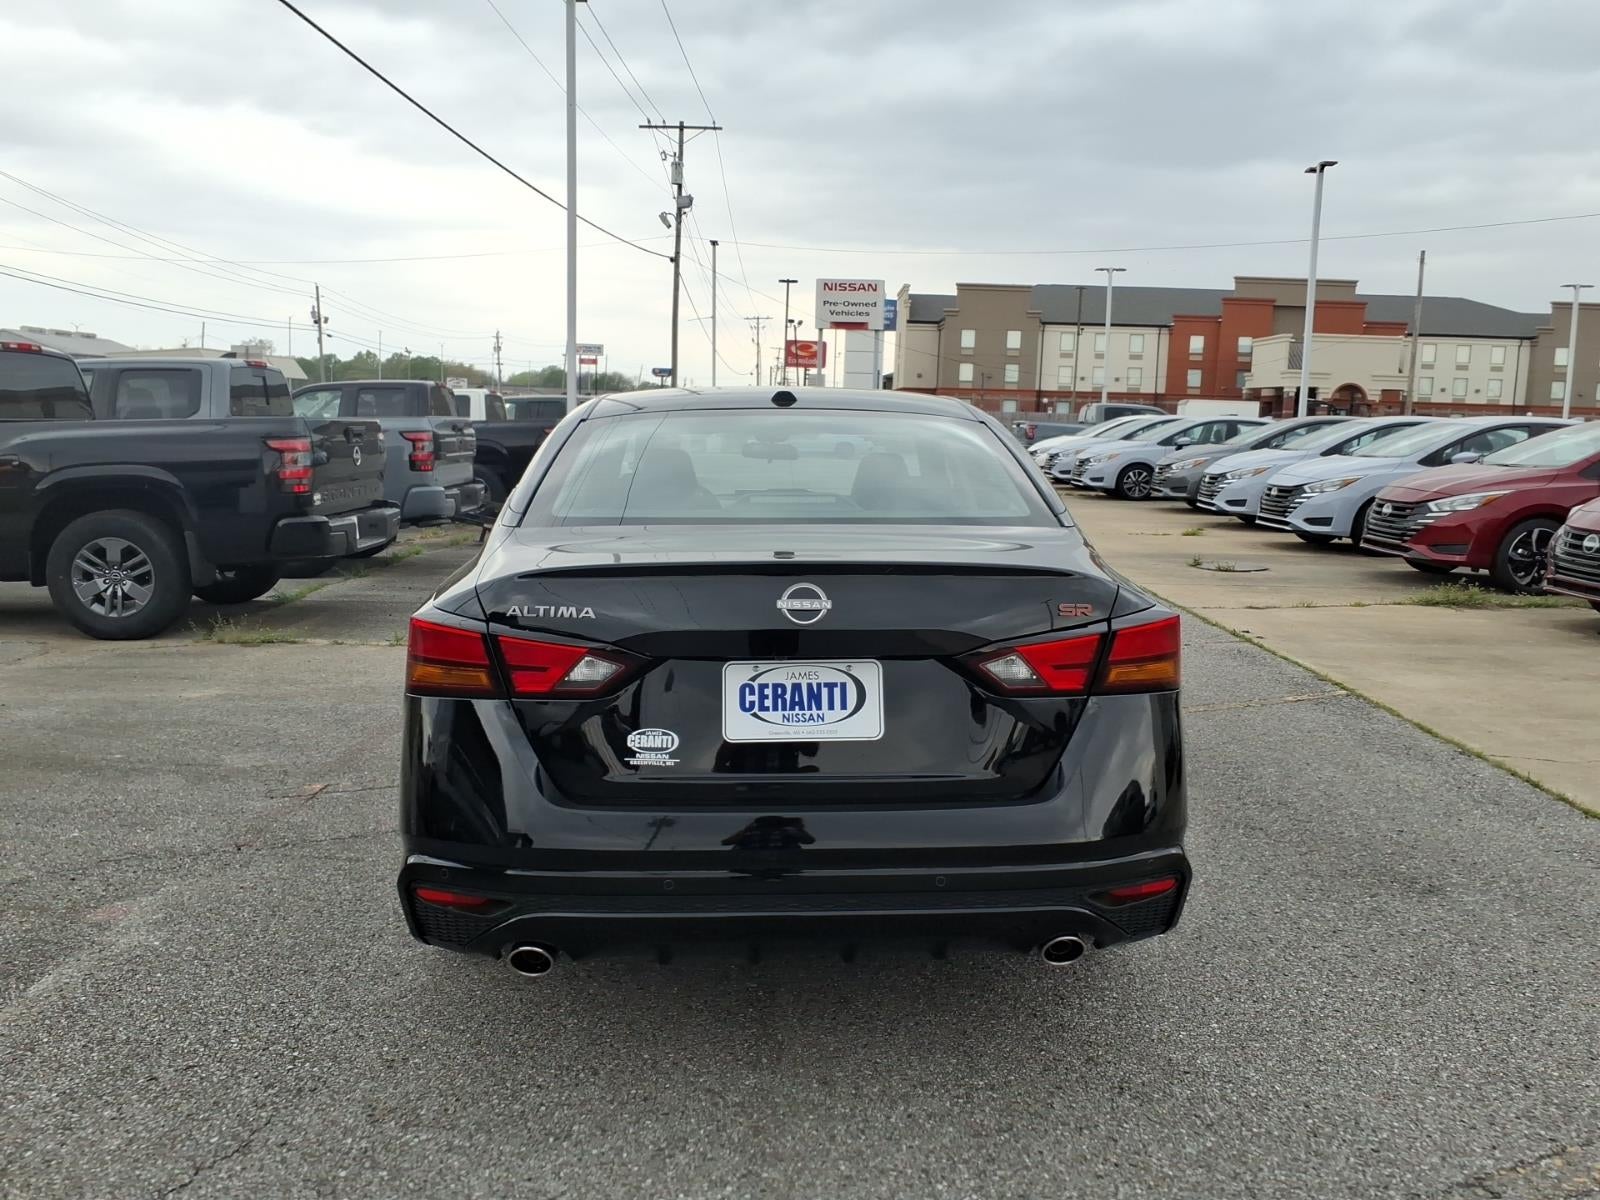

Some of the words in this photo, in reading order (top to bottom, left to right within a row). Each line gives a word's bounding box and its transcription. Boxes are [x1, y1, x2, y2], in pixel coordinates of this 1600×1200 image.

[823, 282, 878, 292] NISSAN
[823, 300, 877, 308] Pre-Owned
[778, 600, 832, 609] NISSAN
[1058, 603, 1093, 616] SR
[506, 605, 597, 619] ALTIMA
[785, 671, 820, 681] JAMES
[738, 681, 848, 713] CERANTI
[782, 713, 825, 723] NISSAN
[627, 734, 672, 748] CERANTI
